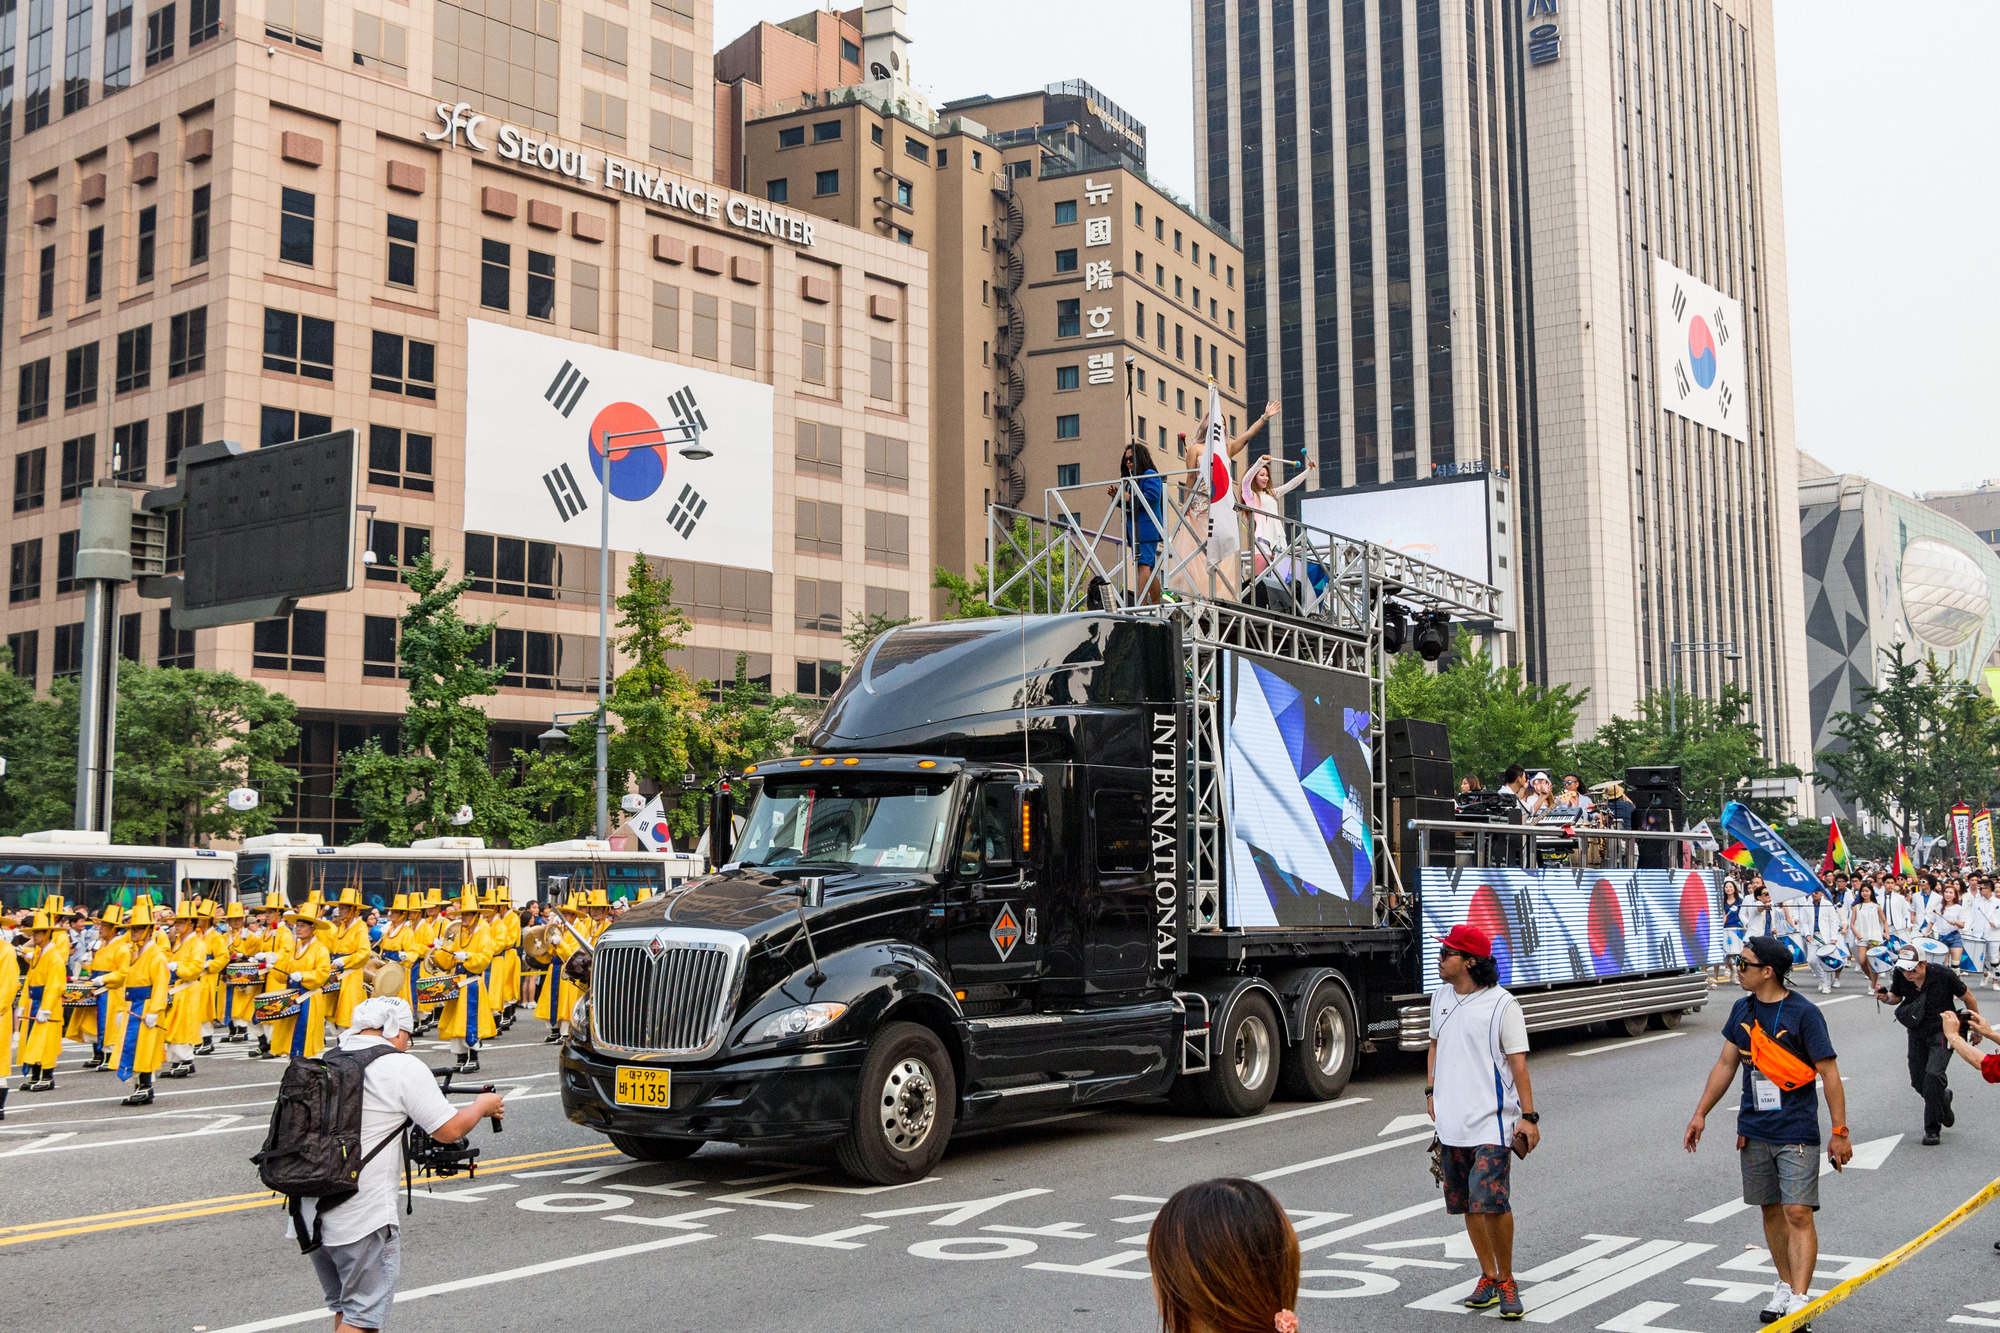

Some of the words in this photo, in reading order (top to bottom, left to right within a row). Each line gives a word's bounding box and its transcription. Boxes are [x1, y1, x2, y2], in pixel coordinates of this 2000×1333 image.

[1434, 460, 1485, 477] 서울신문
[1151, 712, 1177, 970] INTERNATIONAL
[629, 1070, 642, 1080] 대구
[644, 1071, 656, 1081] 99
[619, 1082, 628, 1096] 바
[631, 1083, 665, 1103] 1135
